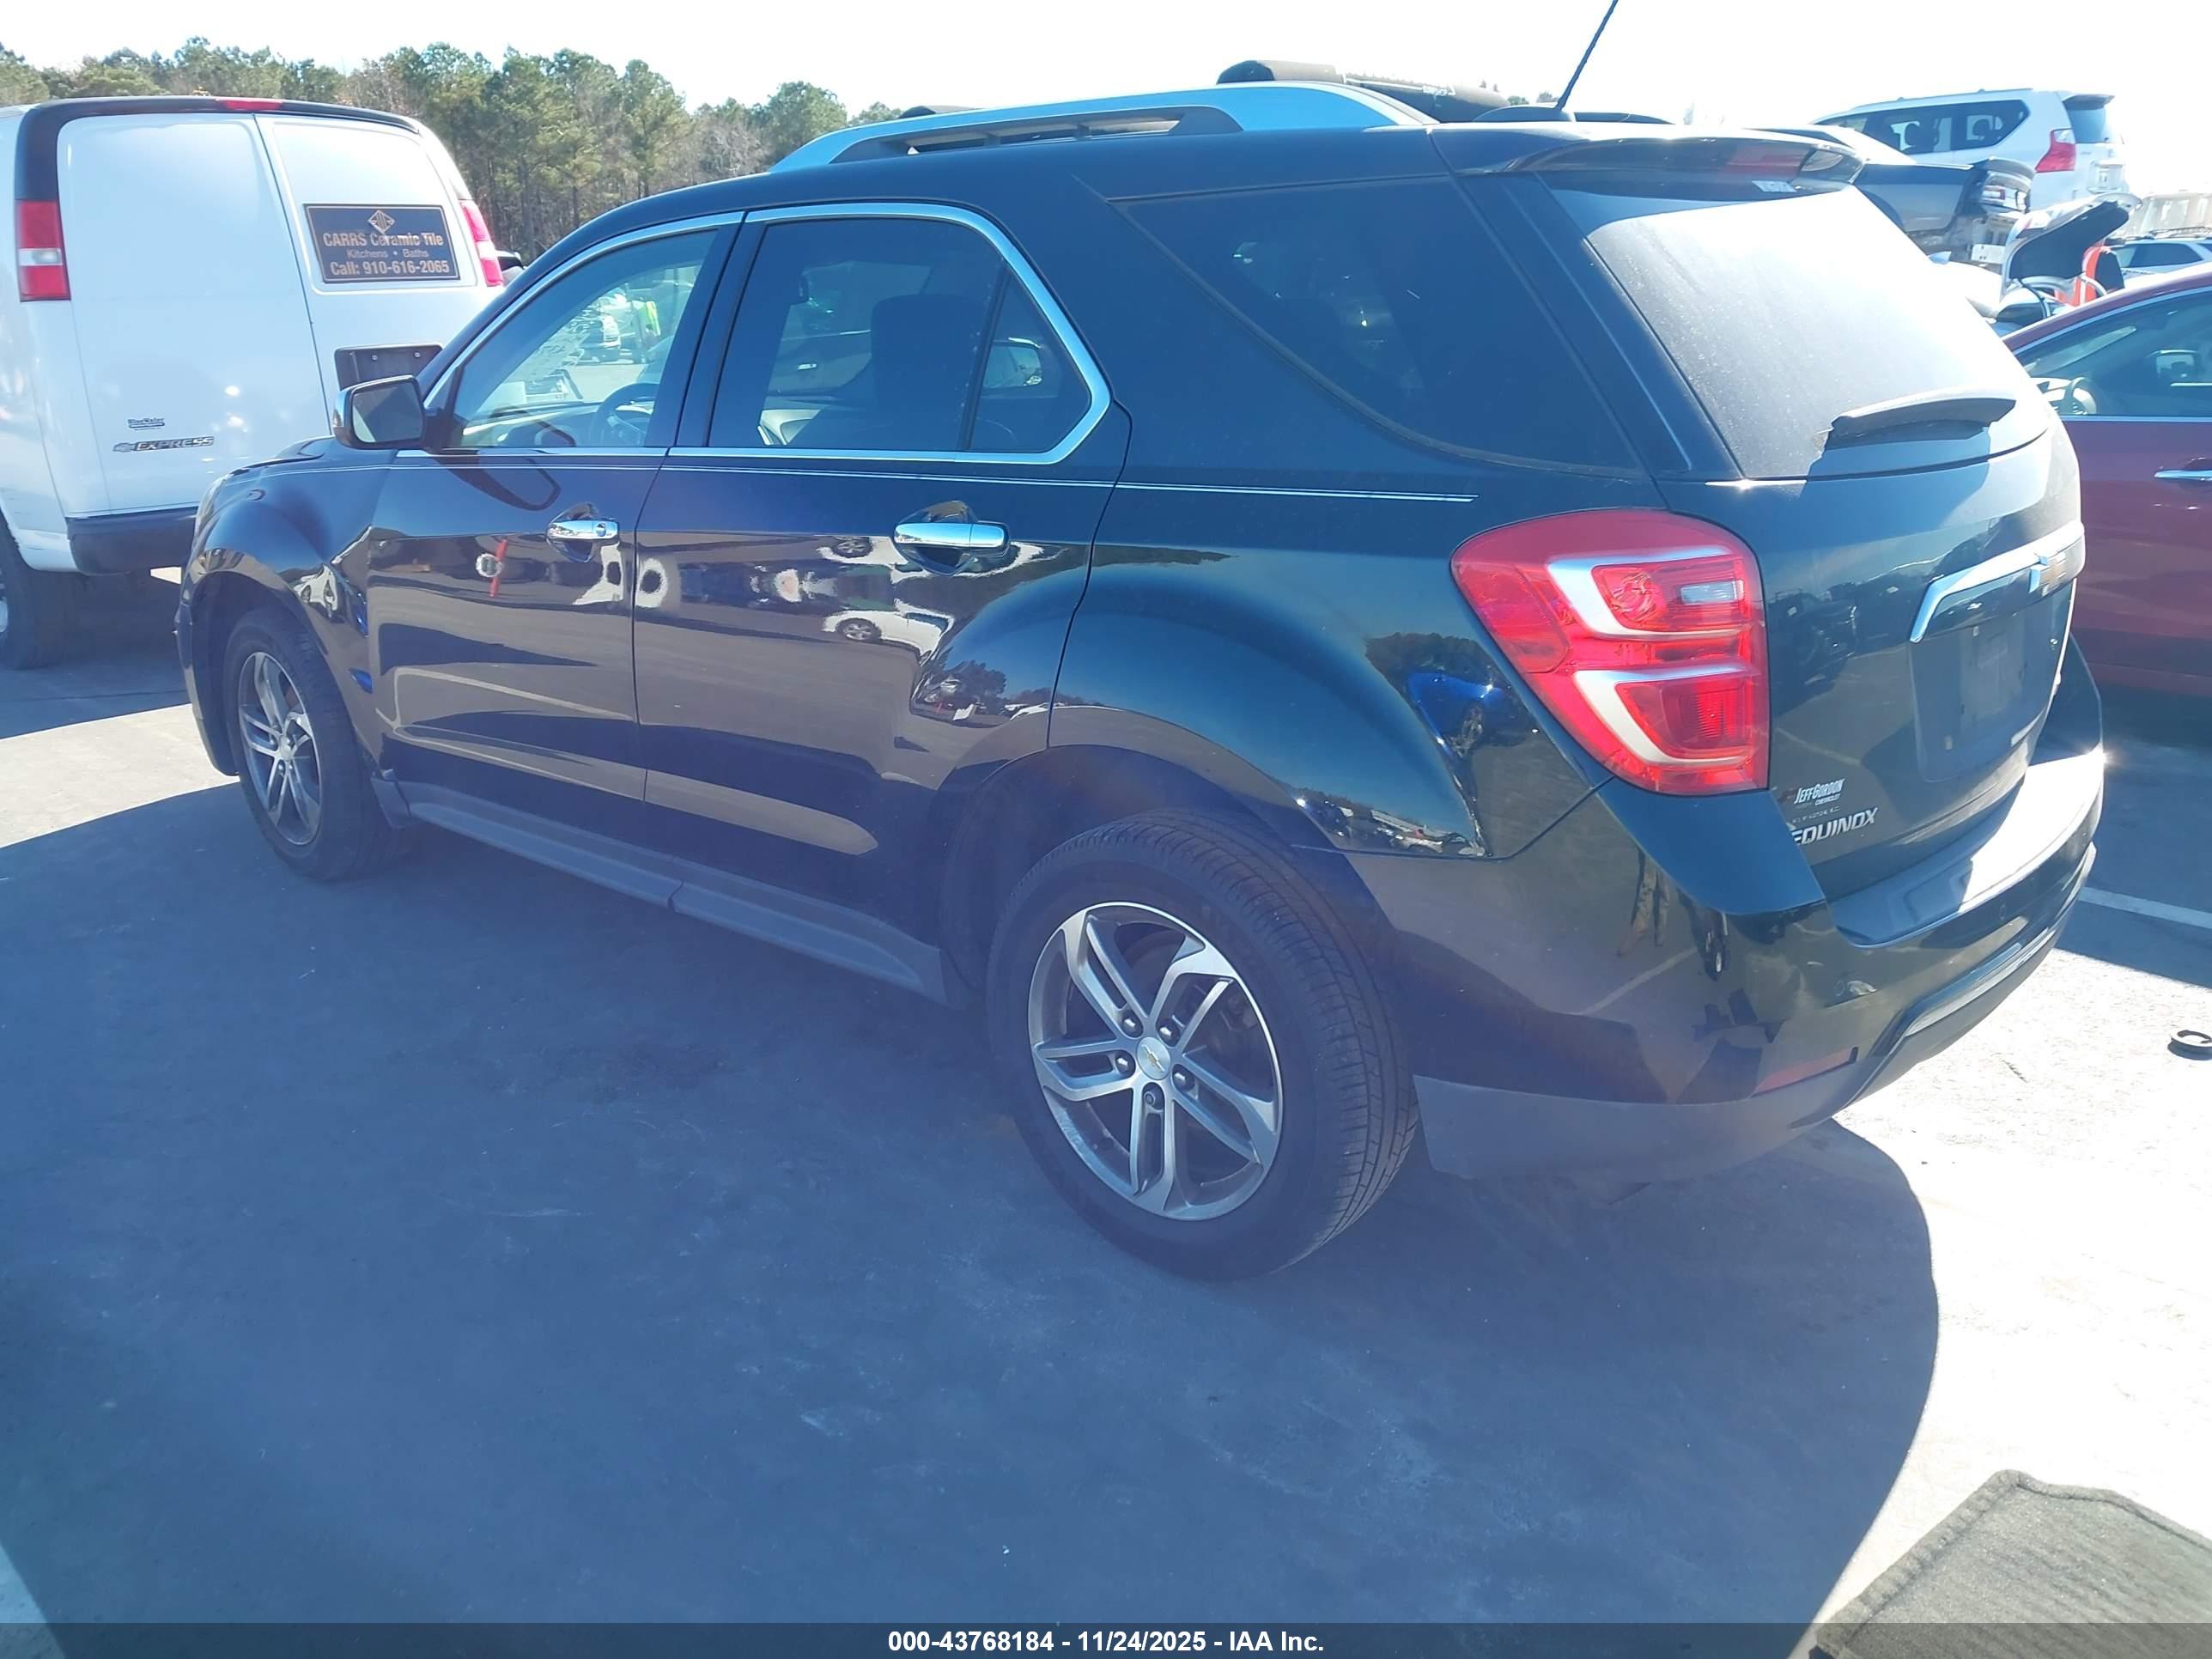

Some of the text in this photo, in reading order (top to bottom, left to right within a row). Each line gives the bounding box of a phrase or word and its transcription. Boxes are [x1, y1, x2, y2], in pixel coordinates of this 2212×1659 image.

[323, 232, 443, 246] CARRS Ceramic Tile
[347, 248, 428, 258] Kitchens Baths
[331, 260, 449, 276] Call: 910-616-2065
[137, 436, 214, 451] EXPRESS
[1791, 807, 1878, 845] EQUINOX
